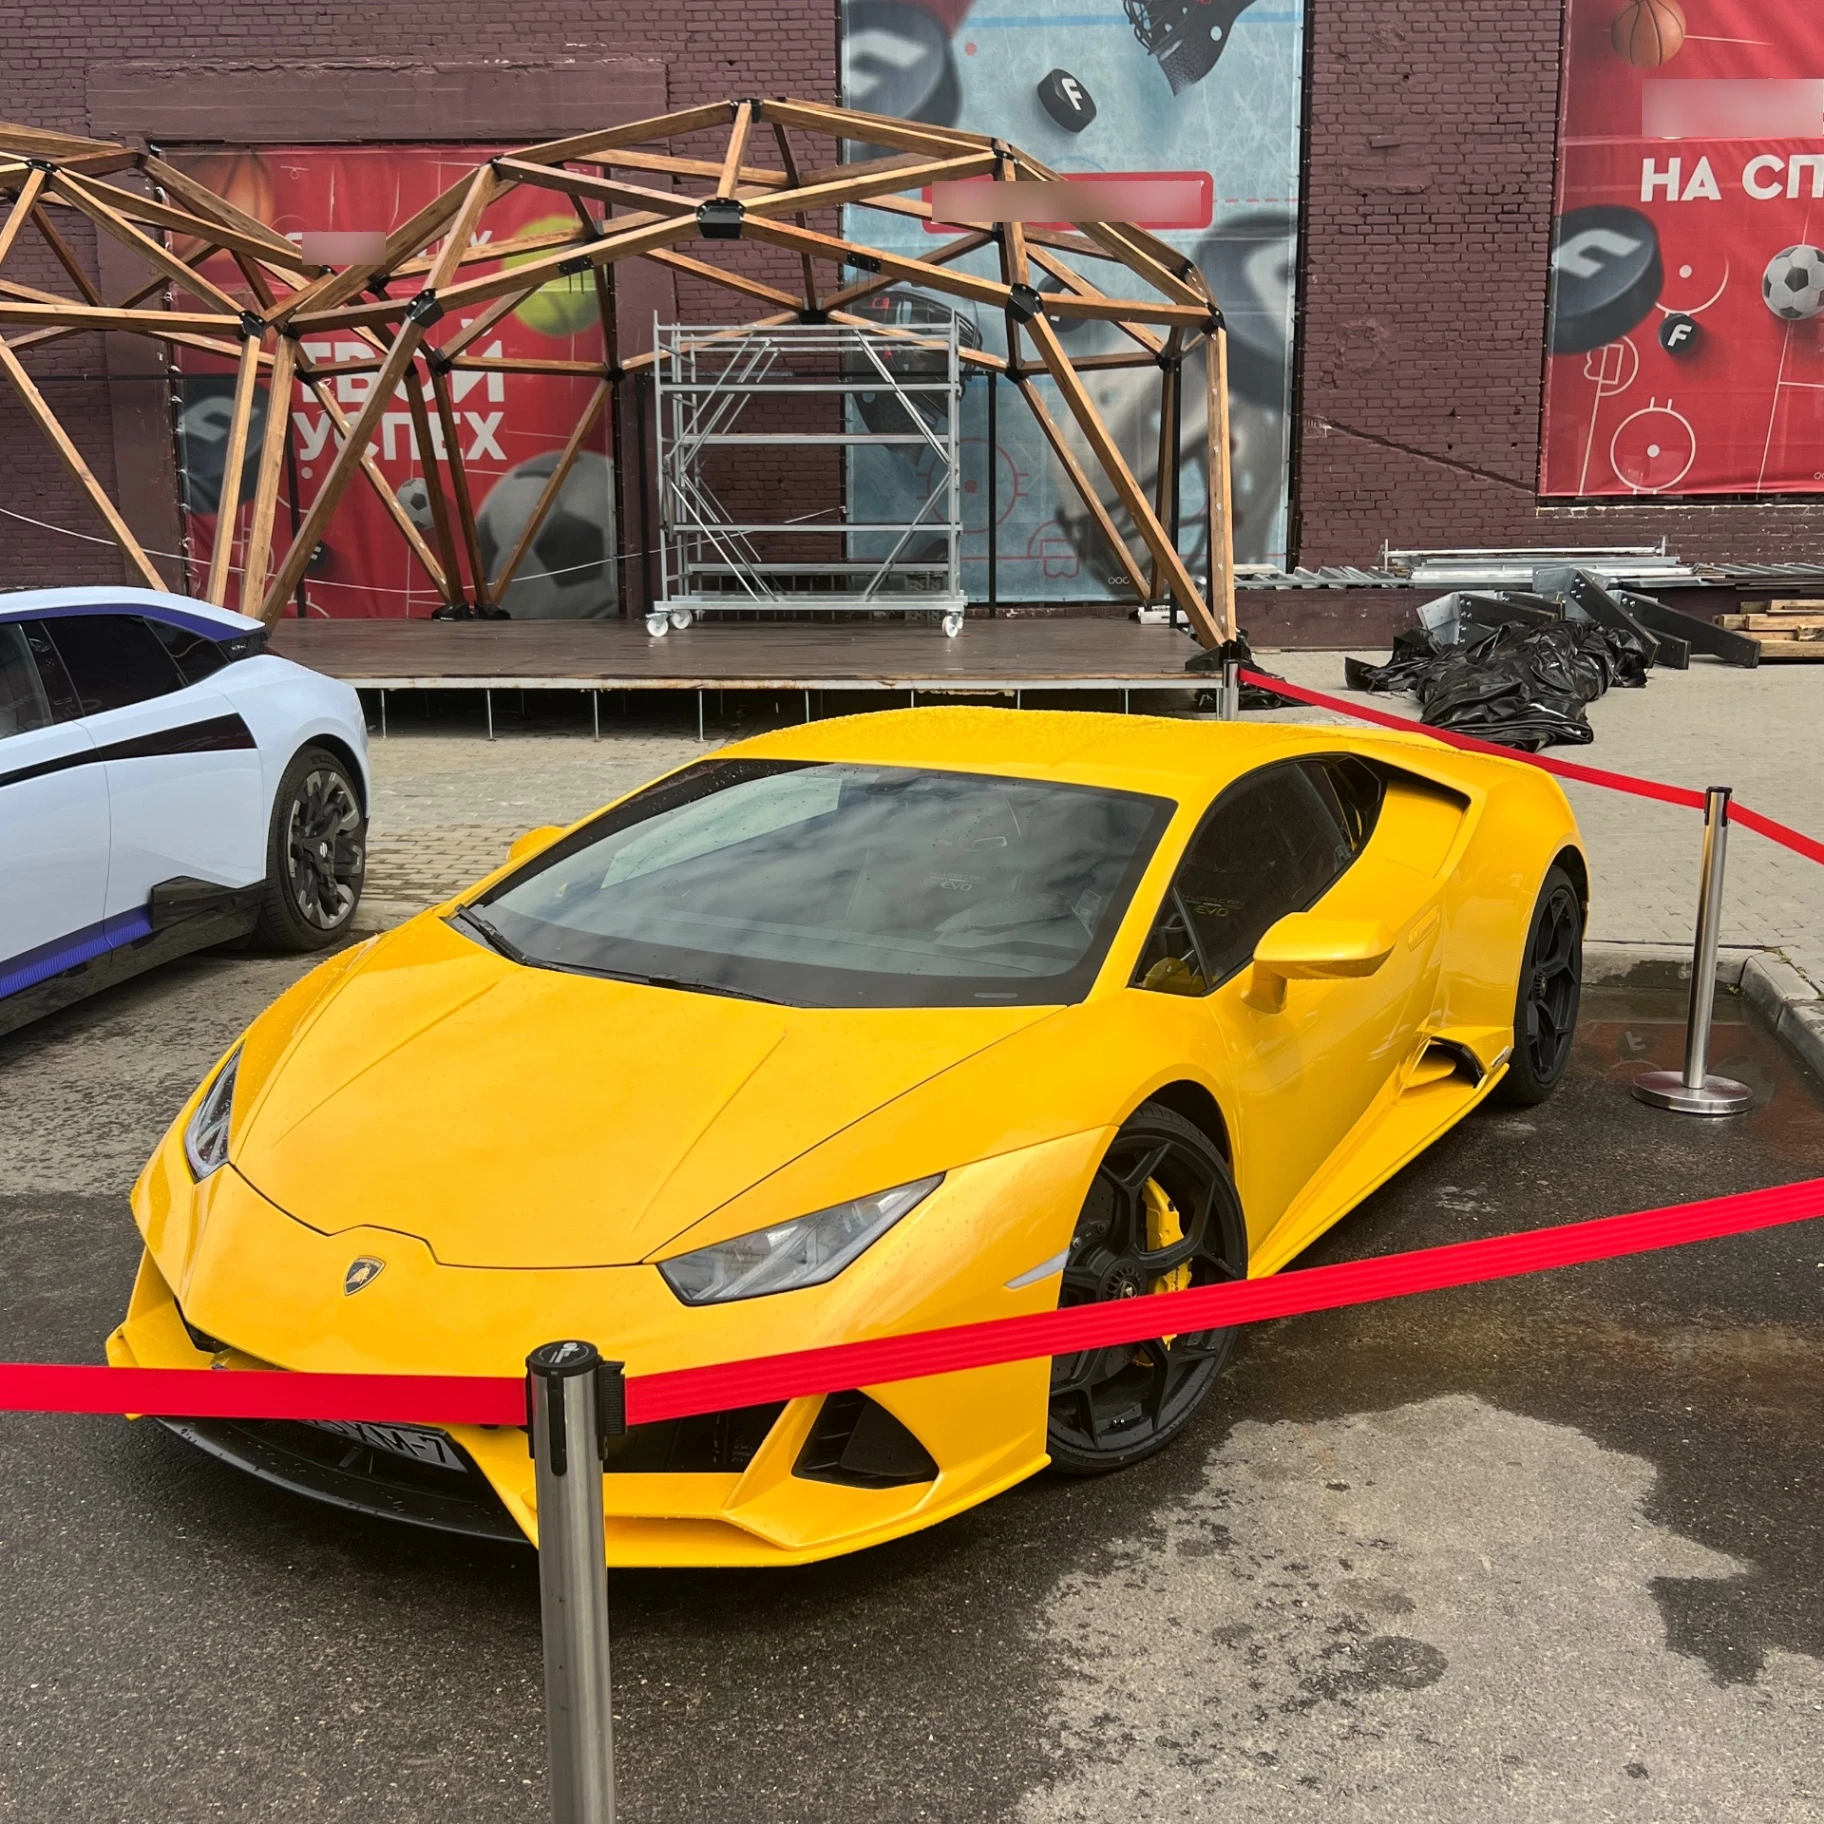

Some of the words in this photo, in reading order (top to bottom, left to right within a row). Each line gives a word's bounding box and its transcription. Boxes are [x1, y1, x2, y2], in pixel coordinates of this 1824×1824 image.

[1061, 78, 1083, 111] F
[1640, 156, 1722, 202] НА
[1667, 323, 1692, 347] F
[1194, 905, 1230, 917] EVO
